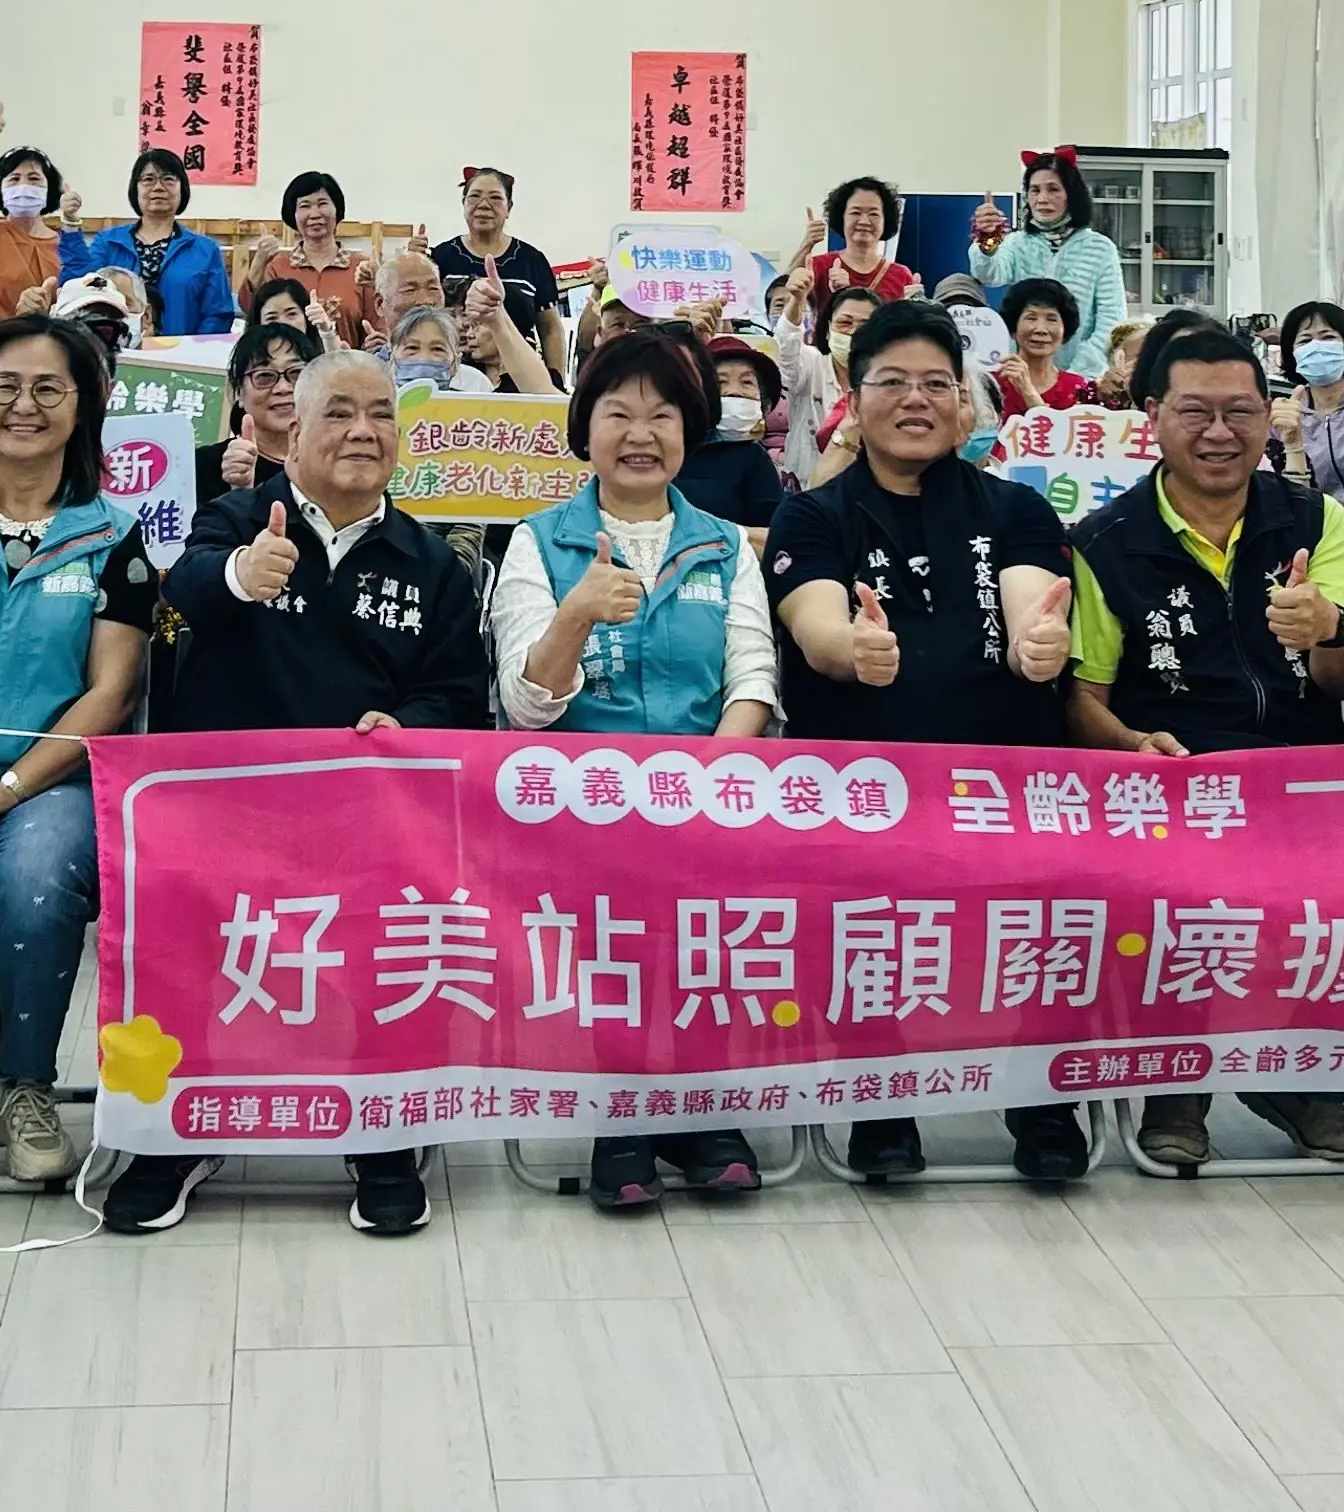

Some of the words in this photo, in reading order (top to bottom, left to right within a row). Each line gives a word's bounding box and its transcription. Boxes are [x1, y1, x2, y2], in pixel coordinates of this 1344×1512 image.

[181, 35, 210, 171] 斐譽全國
[666, 65, 692, 196] 卓越超群
[631, 245, 732, 272] 快樂運動
[636, 279, 737, 303] 健康生活
[408, 420, 574, 456] 銀齡新處
[1006, 411, 1160, 461] 健康生
[109, 445, 154, 492] 新
[387, 462, 589, 500] 健康老化新主
[1047, 472, 1149, 514] 自主
[138, 500, 183, 546] 維
[868, 548, 893, 601] 鎮長
[969, 535, 1002, 664] 布袋鎮公所
[1167, 585, 1198, 637] 議員
[514, 762, 893, 821] 嘉義縣布袋鎮
[947, 768, 1248, 840] 全齡樂學
[188, 1094, 342, 1134] 指導單位
[1060, 1051, 1204, 1087] 主辦單位
